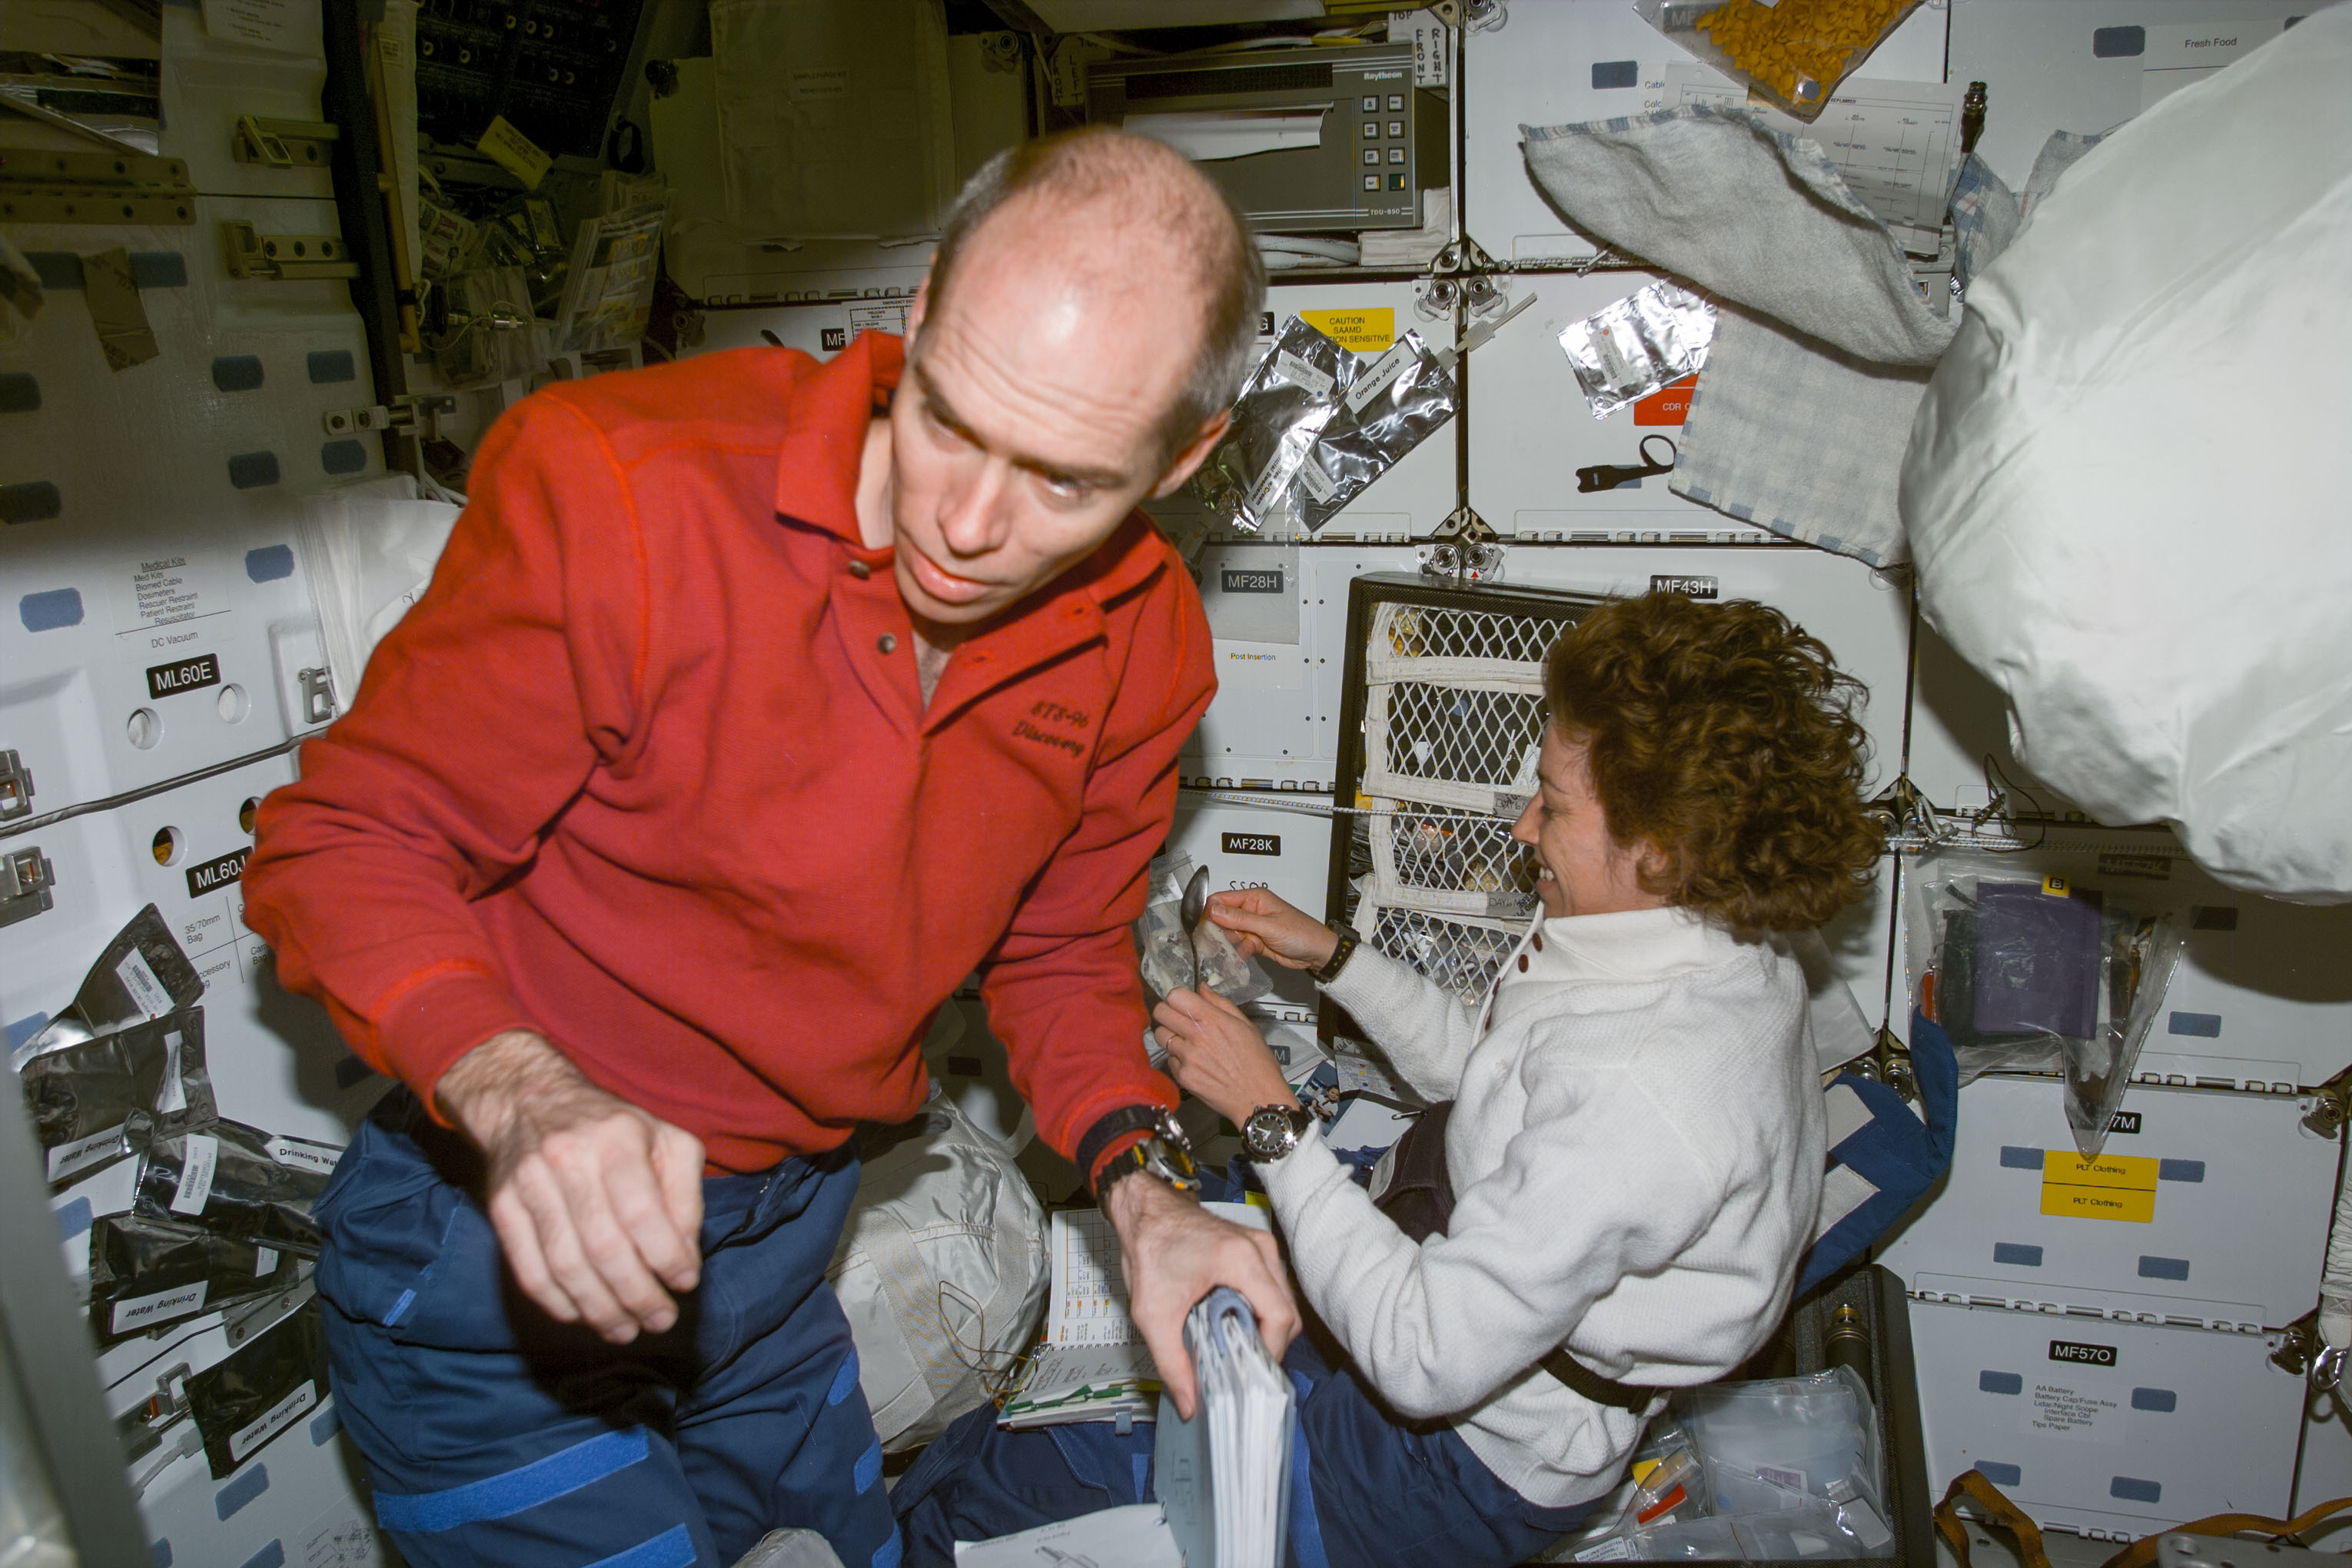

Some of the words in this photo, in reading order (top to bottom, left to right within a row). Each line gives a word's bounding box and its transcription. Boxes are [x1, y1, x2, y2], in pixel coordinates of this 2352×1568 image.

[2184, 39, 2211, 48] Fresh
[2214, 38, 2237, 46] Food
[1416, 28, 1426, 84] FRONT
[1431, 28, 1442, 83] RIGHT
[1364, 71, 1403, 81] Raytheon
[1329, 317, 1365, 325] CAUTION
[1349, 334, 1390, 343] SENSITIVE
[1355, 376, 1380, 400] Orange
[1381, 357, 1400, 377] Juice
[1663, 403, 1681, 411] CDR
[141, 559, 170, 572] Medical
[171, 556, 186, 568] Kits
[134, 573, 150, 583] Med
[135, 580, 162, 592] Biomed
[163, 577, 183, 587] Cable
[1227, 575, 1277, 589] MF28H
[1656, 580, 1711, 594] MF43H
[138, 588, 176, 601] Dosimeters
[139, 599, 167, 610] Rescuer
[168, 592, 199, 604] Restraint
[141, 608, 164, 619] Patient
[166, 602, 195, 614] Restraint
[154, 611, 195, 626] Resuscitator
[151, 637, 164, 649] DC
[166, 632, 198, 645] Vacuum
[1247, 653, 1276, 661] Insertion
[155, 661, 213, 691] ML60E
[1012, 720, 1085, 758] Discovery
[1229, 838, 1273, 851] MF28K
[2051, 879, 2063, 889] B
[187, 932, 203, 945] Bag
[251, 943, 269, 955] Cam
[198, 960, 231, 979] ccessory
[85, 1134, 120, 1153] Drinking
[60, 1149, 83, 1164] Water
[279, 1148, 319, 1163] Drinking
[321, 1156, 337, 1166] Wat
[2093, 1164, 2126, 1175] Clothing
[2090, 1198, 2123, 1208] Clothing
[157, 1292, 198, 1310] Drinking
[125, 1304, 154, 1317] Water
[2048, 1386, 2075, 1395] Battery
[2035, 1392, 2061, 1402] Battery
[2099, 1400, 2118, 1408] Assy
[270, 1392, 306, 1423] Drinking
[2045, 1408, 2076, 1417] Interface
[2075, 1405, 2098, 1414] Scope
[2031, 1420, 2047, 1428] Tips
[2067, 1417, 2093, 1427] Battery
[241, 1422, 267, 1445] Water
